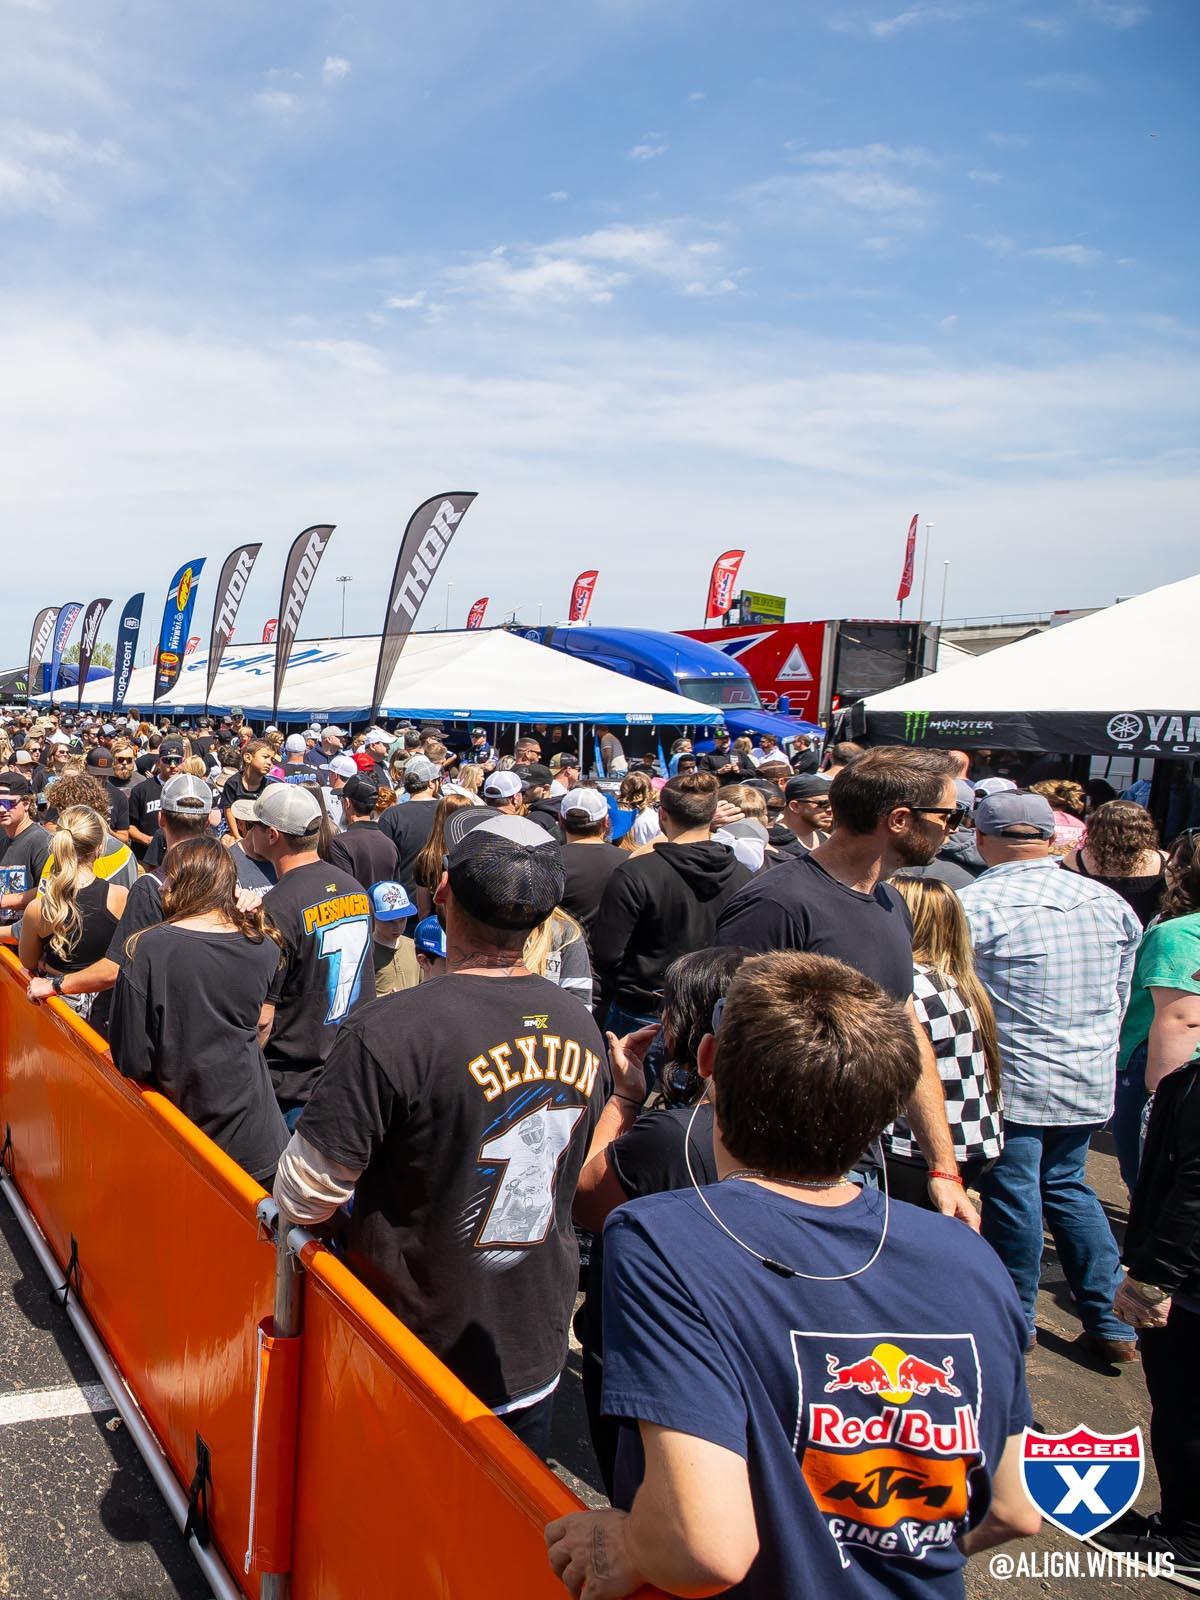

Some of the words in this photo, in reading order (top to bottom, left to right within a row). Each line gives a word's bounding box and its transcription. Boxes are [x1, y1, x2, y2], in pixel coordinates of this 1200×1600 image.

[281, 532, 327, 634] THOR
[392, 500, 464, 620] THOR
[215, 551, 255, 637] THOR
[31, 610, 58, 661] THOR
[117, 641, 132, 702] 100Percent
[930, 720, 993, 729] MONSTER
[320, 919, 370, 1025] 7
[523, 1016, 548, 1029] SMX
[468, 1035, 601, 1102] SEXTON
[475, 1098, 587, 1247] 1
[808, 1403, 899, 1448] Red
[899, 1404, 980, 1455] Bull
[822, 1466, 952, 1509] KTM
